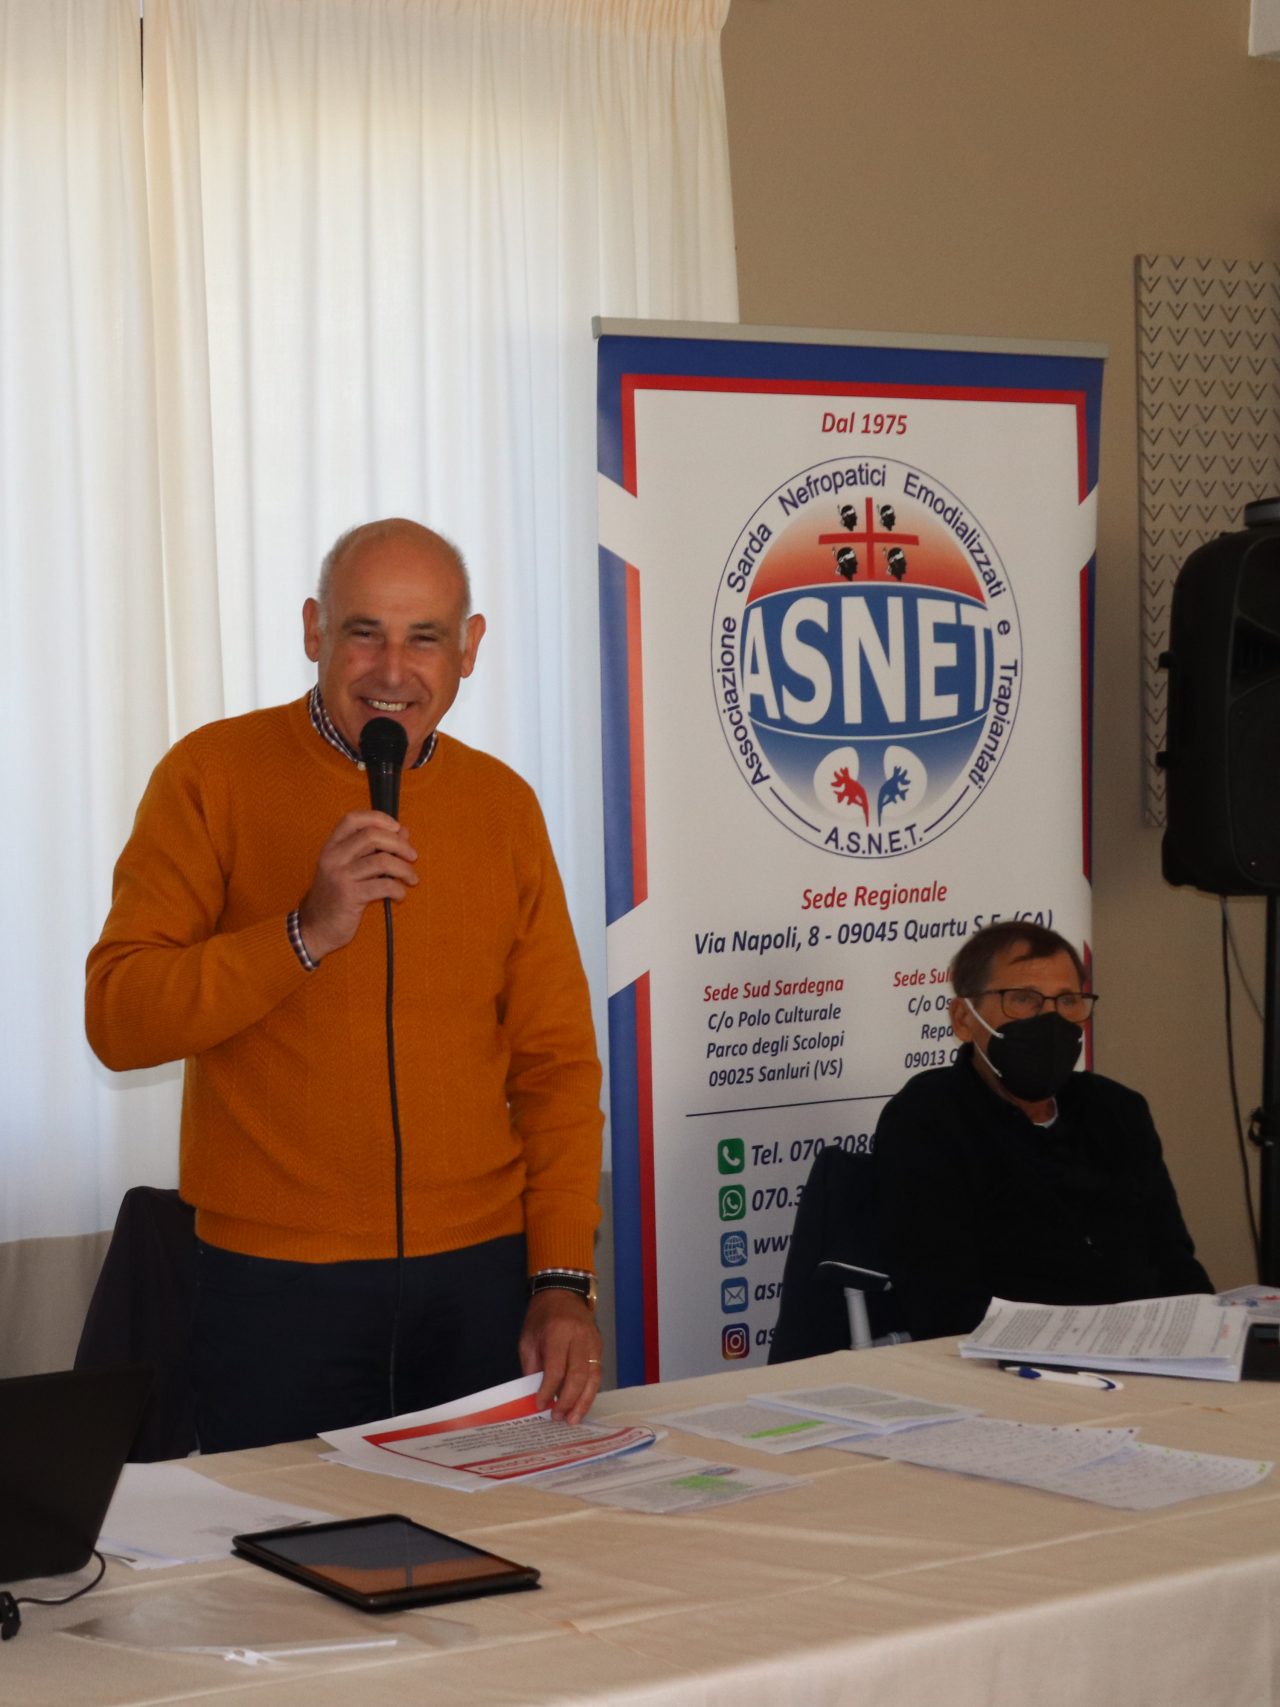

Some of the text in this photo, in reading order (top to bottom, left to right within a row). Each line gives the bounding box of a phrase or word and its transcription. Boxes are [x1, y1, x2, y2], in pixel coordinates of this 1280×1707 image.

[821, 411, 908, 435] Dal 1975
[717, 462, 1018, 789] Associazione Sarda Nefropatici Emodializzati e Trapiantati
[743, 596, 992, 725] ASNET
[824, 823, 923, 855] A.S.N.E.T.
[801, 880, 947, 910] Sede Regionale
[695, 932, 726, 955] Via
[732, 926, 802, 955] Napoli,
[808, 926, 820, 947] 8
[837, 921, 899, 945] 09045
[904, 918, 968, 942] Quartu
[703, 977, 844, 1002] Sede Sud Sardegna
[893, 968, 926, 987] Sede
[708, 1003, 842, 1032] C/o Polo Culturale
[908, 995, 931, 1016] C/o
[706, 1030, 845, 1059] Parco degli Scolopi
[904, 1049, 946, 1069] 09013
[709, 1058, 843, 1087] 09025 Sanluri (VS)
[752, 1141, 783, 1166] Tel.
